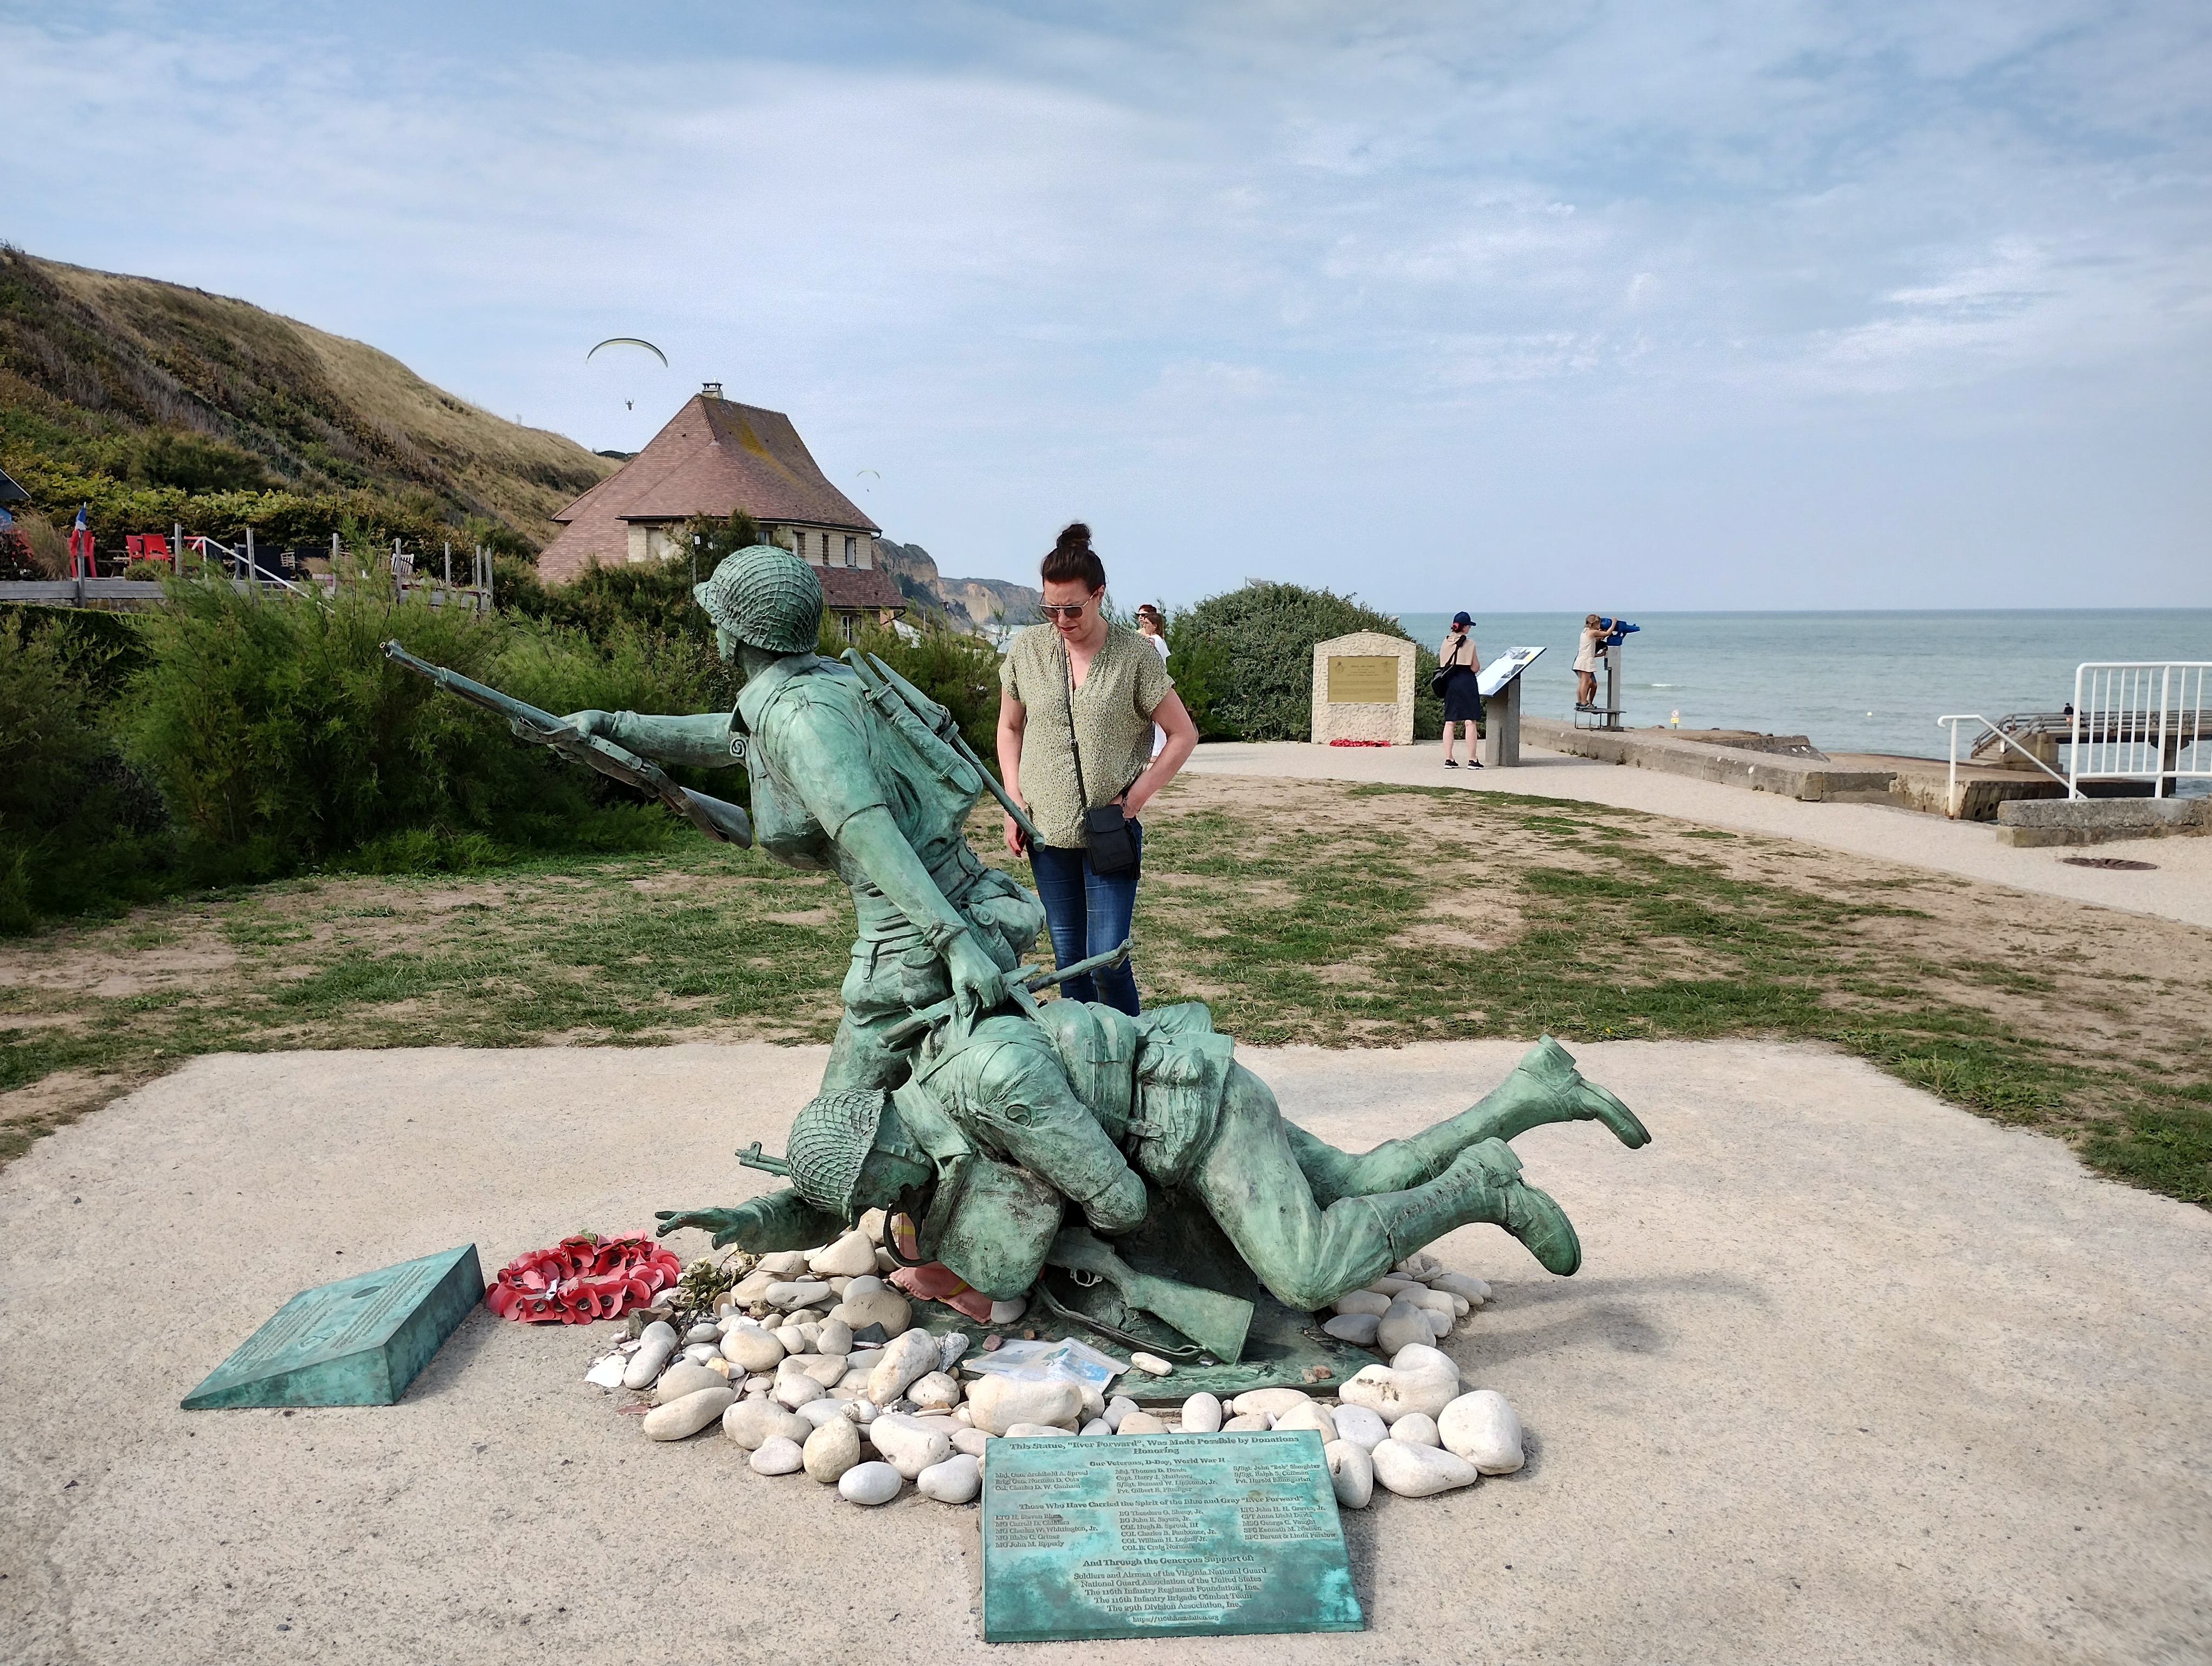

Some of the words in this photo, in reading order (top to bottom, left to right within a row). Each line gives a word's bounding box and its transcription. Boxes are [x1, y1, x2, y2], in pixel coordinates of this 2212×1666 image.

[1238, 1437, 1249, 1445] by
[1103, 1558, 1142, 1566] Through
[1204, 1555, 1240, 1564] Support
[1175, 1568, 1206, 1577] Virginia
[1167, 1594, 1197, 1602] Brigade
[1124, 1605, 1142, 1613] 29th
